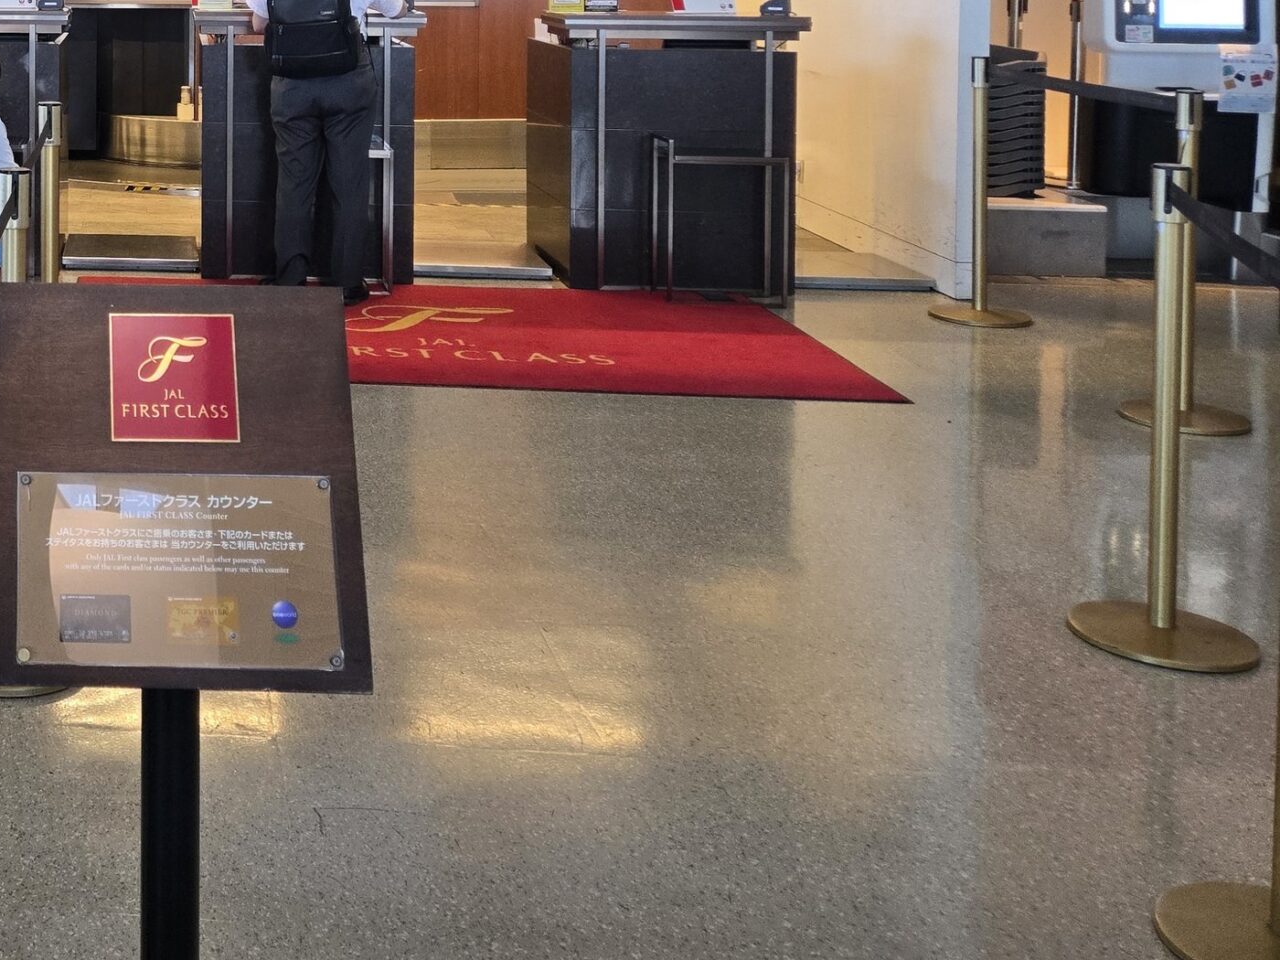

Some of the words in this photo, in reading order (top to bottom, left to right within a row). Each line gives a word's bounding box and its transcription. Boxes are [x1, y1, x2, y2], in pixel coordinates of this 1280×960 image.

[348, 346, 434, 358] RST
[454, 350, 616, 365] CLASS
[164, 389, 184, 400] JAL
[122, 404, 170, 418] FIRST
[175, 405, 228, 419] CLASS
[74, 494, 200, 508] JALファーストクラス
[207, 495, 272, 509] カウンター
[138, 511, 161, 519] FIRST
[196, 511, 228, 520] Counter
